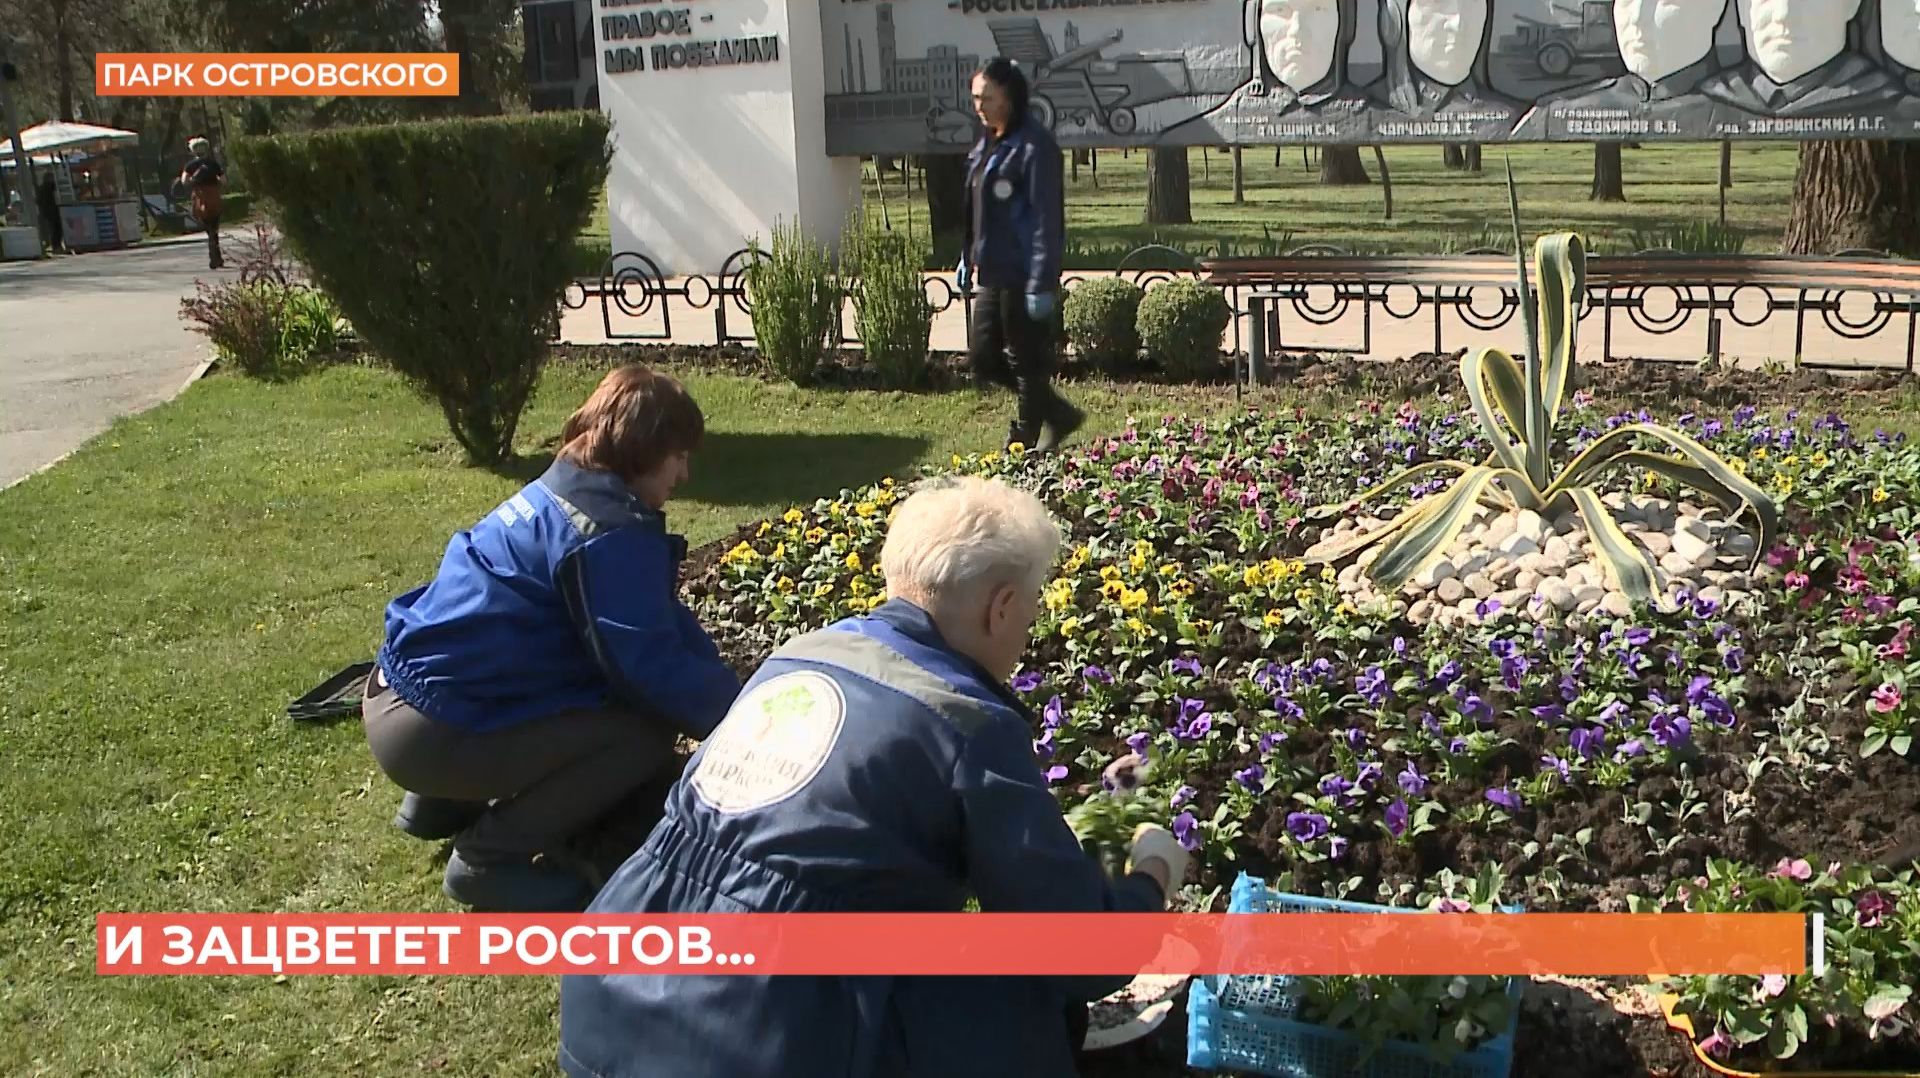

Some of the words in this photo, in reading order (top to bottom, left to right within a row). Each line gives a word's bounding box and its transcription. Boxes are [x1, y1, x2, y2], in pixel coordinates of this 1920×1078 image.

[601, 9, 691, 41] ПРАВОЕ
[605, 46, 644, 73] МЫ
[651, 36, 779, 71] ПОБЕДИЛИ
